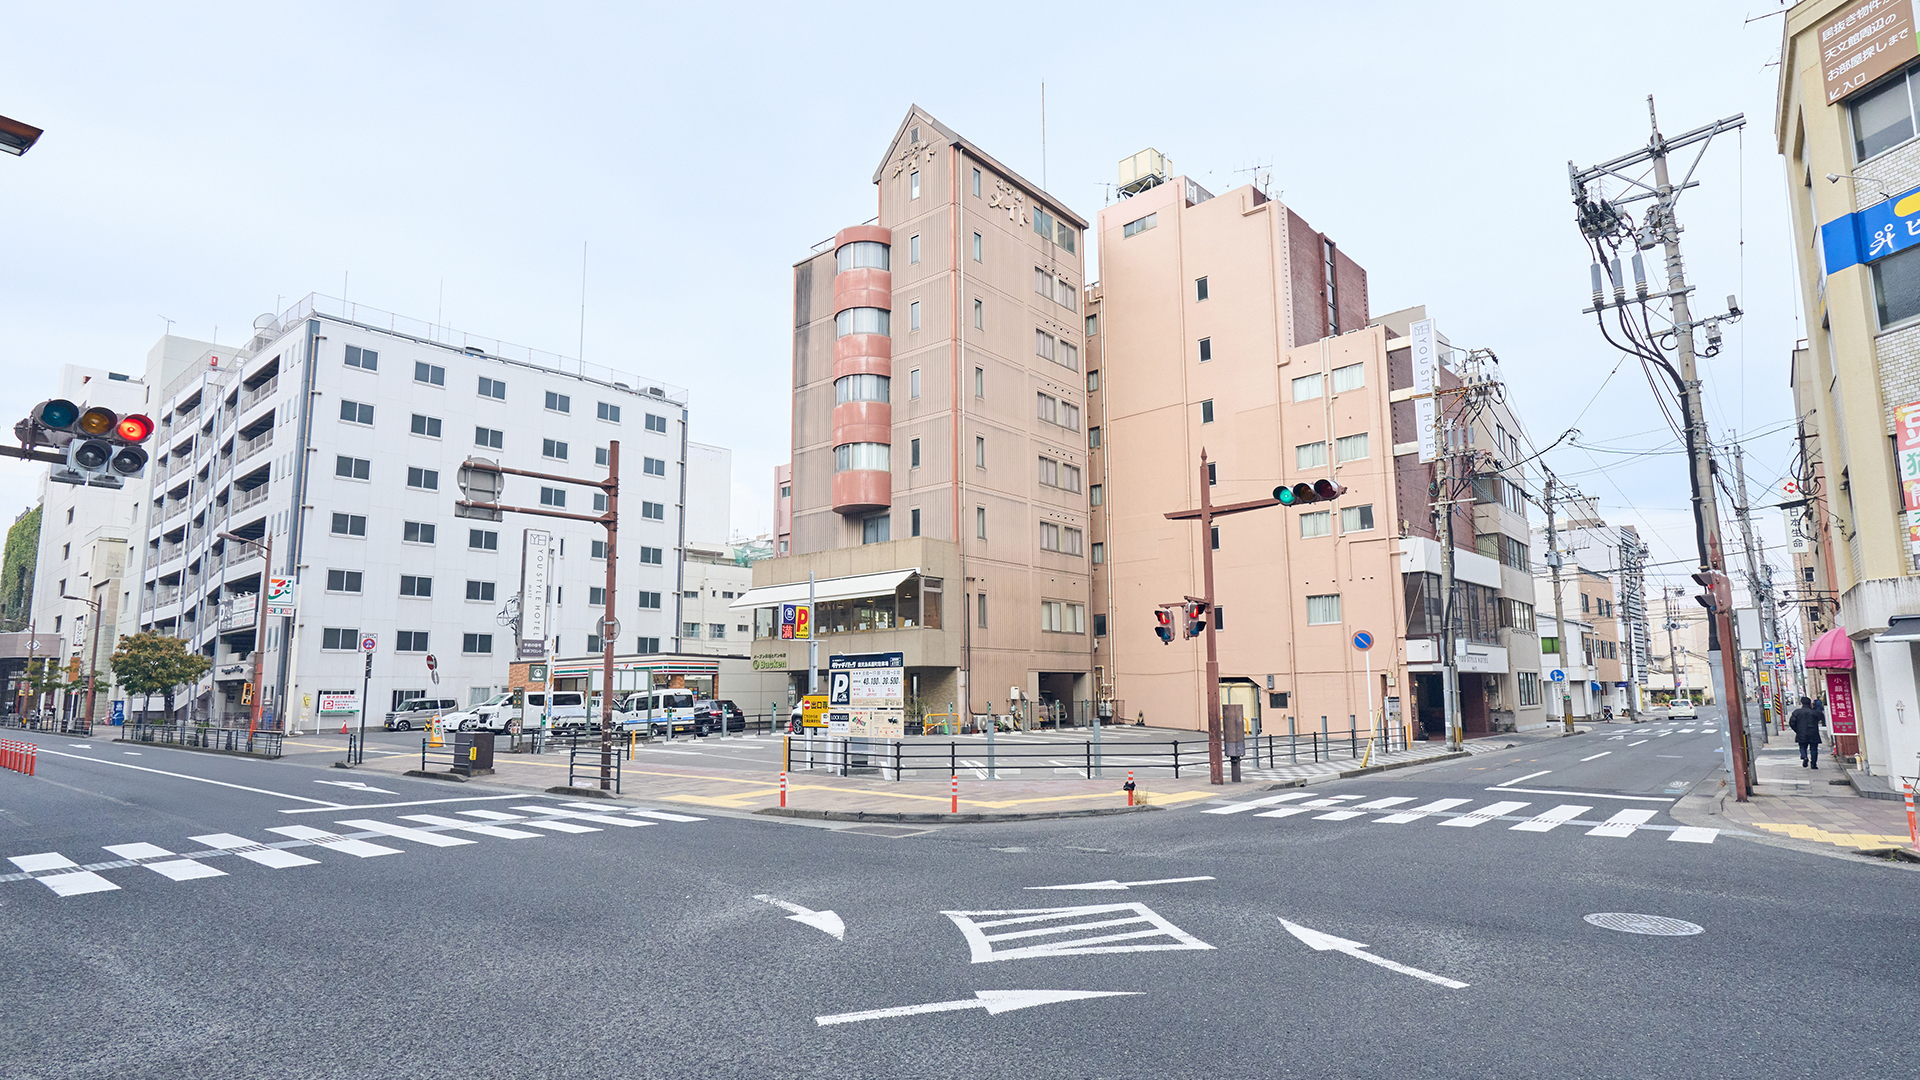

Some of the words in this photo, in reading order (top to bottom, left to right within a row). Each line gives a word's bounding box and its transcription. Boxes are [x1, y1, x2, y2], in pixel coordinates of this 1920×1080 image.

[1822, 0, 1890, 42] 居抜き物件
[1824, 13, 1896, 62] 天文館周辺の
[1827, 27, 1909, 81] お部屋探しまで
[1843, 72, 1866, 93] 入口
[988, 192, 1030, 227] メイト
[1418, 337, 1428, 364] YOU
[1420, 369, 1432, 409] STYE
[1790, 507, 1804, 548] 日本生命
[535, 572, 543, 600] STYLE
[533, 604, 542, 636] HOTEL
[797, 609, 808, 632] P
[1764, 643, 1771, 652] P
[760, 660, 786, 669] Backen
[832, 674, 849, 702] P
